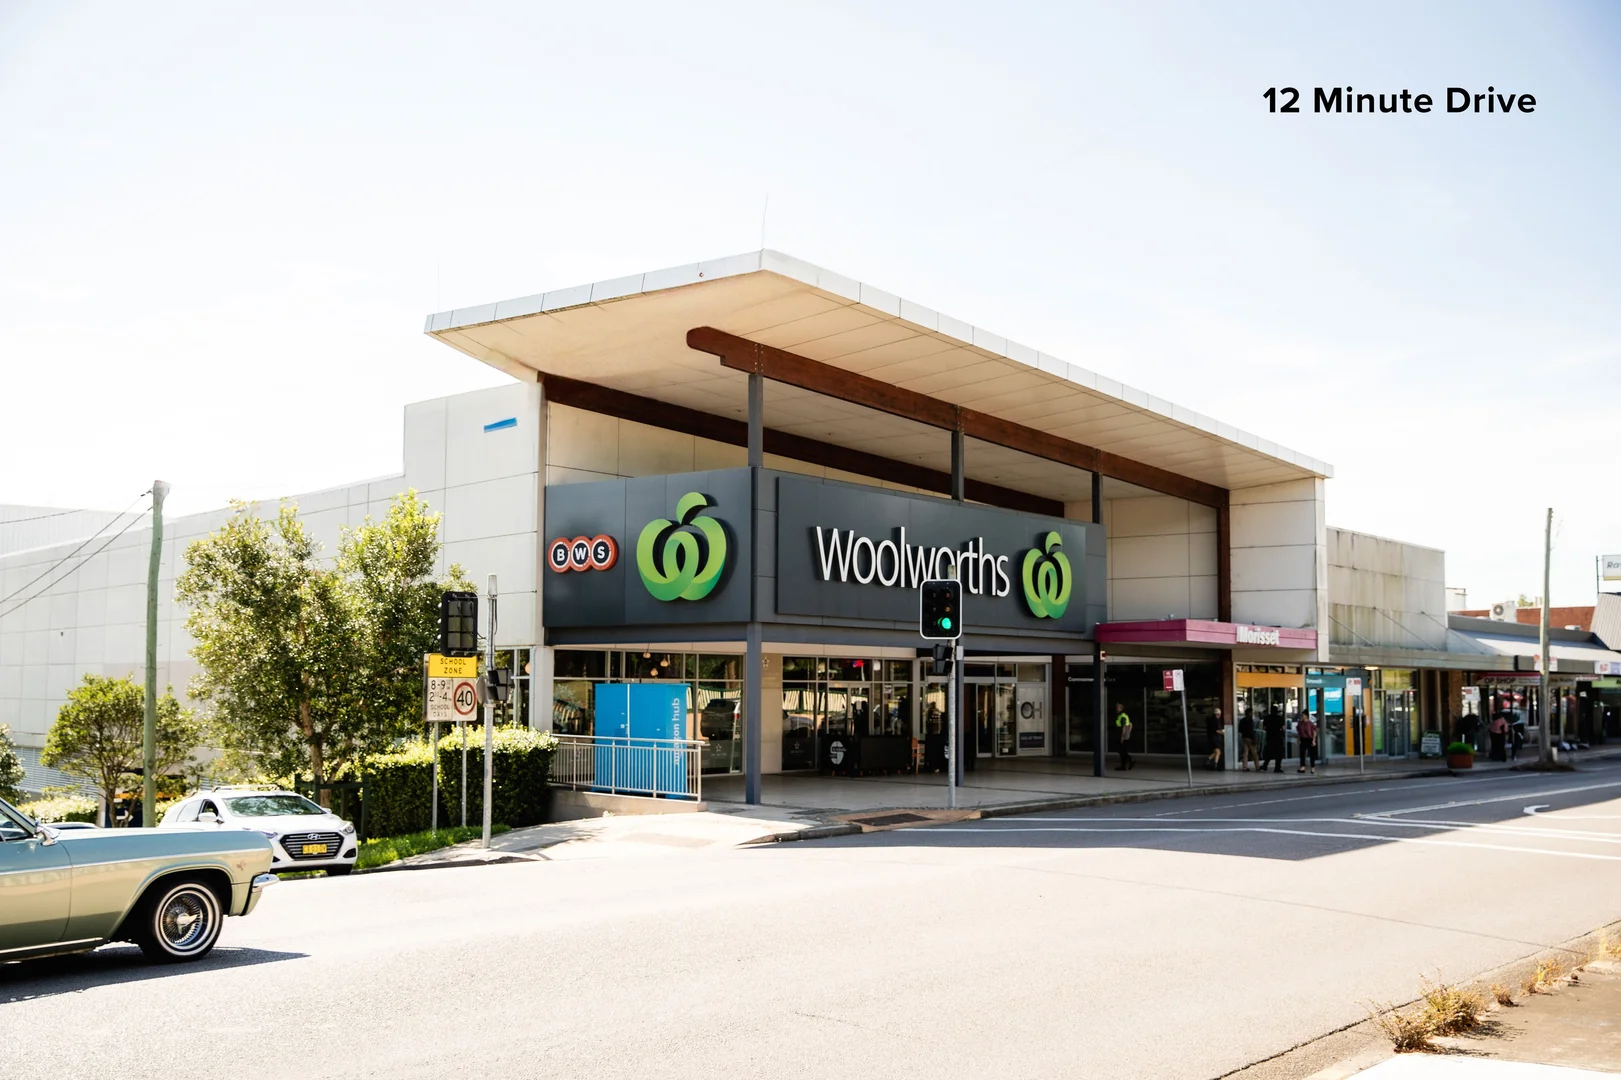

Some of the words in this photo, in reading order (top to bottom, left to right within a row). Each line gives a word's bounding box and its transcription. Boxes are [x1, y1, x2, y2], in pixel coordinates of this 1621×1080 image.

[556, 546, 605, 561] BWS
[816, 526, 1010, 597] Woolworths
[1606, 560, 1621, 570] Ra
[1236, 626, 1279, 645] Morisset
[456, 690, 473, 706] 40
[672, 697, 680, 721] hub
